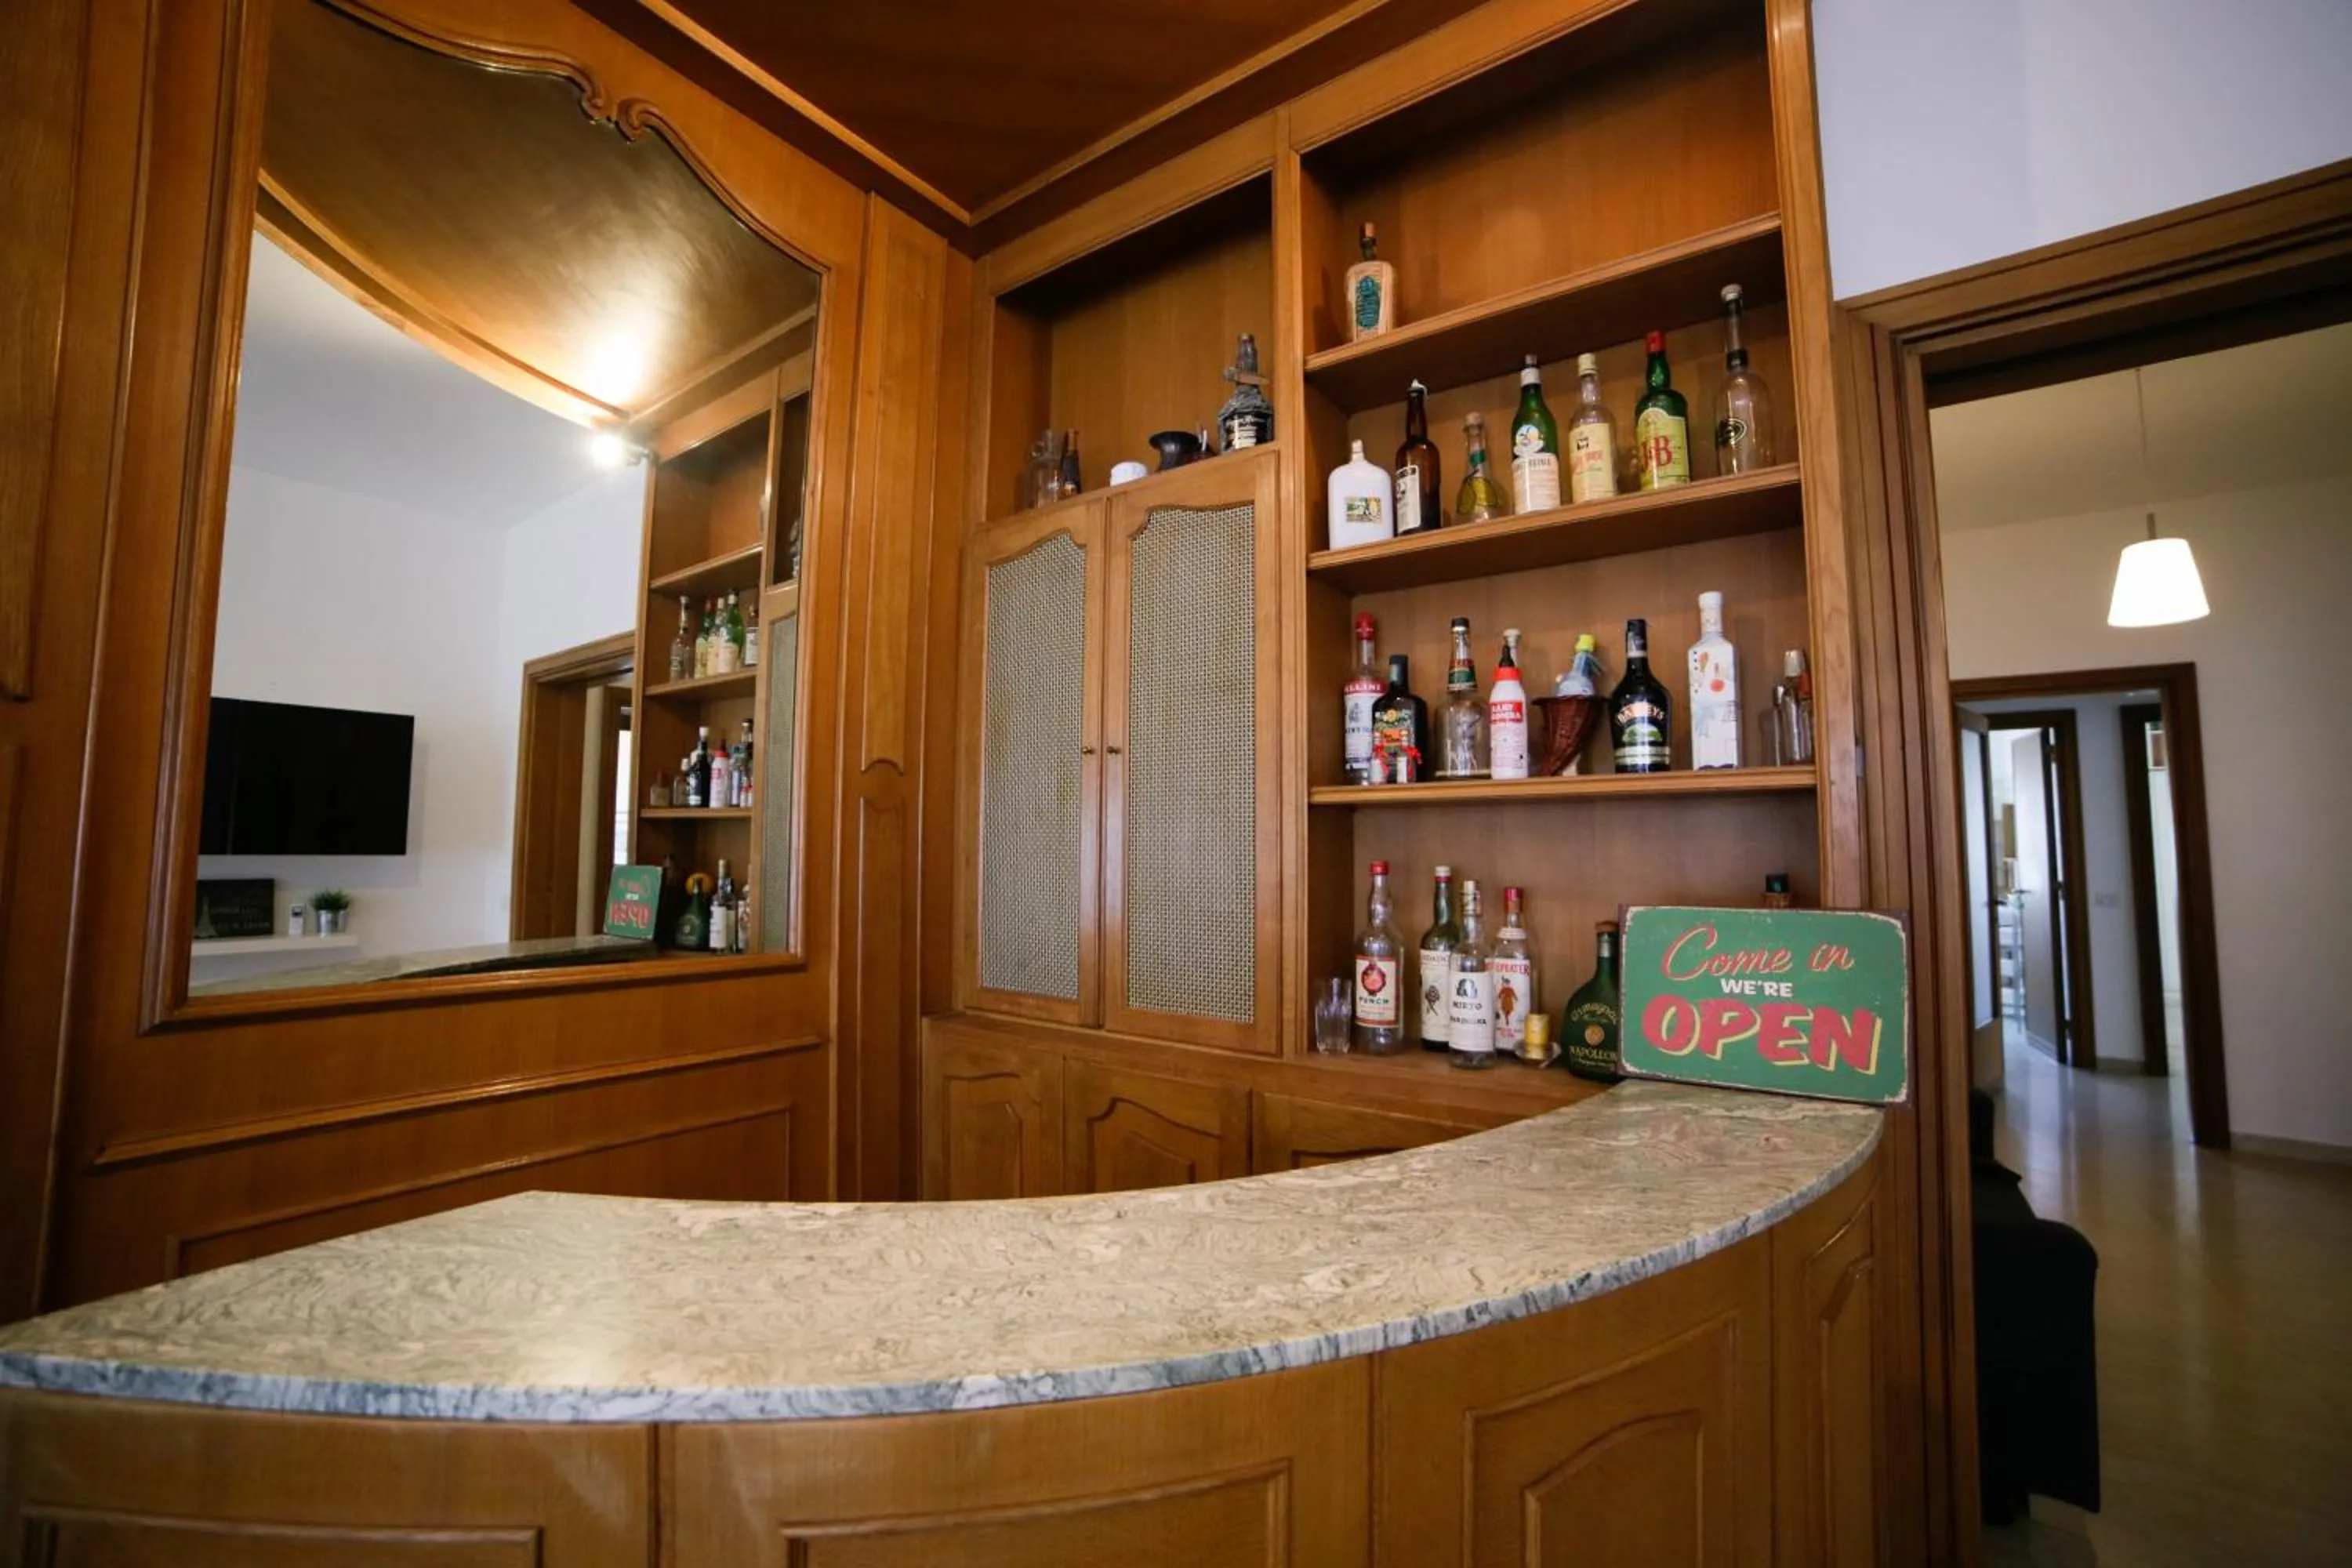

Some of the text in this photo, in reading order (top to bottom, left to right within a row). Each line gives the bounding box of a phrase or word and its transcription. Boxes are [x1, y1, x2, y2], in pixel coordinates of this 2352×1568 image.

[1617, 701, 1664, 726] BAEYS
[1661, 924, 1856, 981] Come in
[1721, 978, 1793, 997] WE'RE
[1641, 994, 1882, 1076] OPEN
